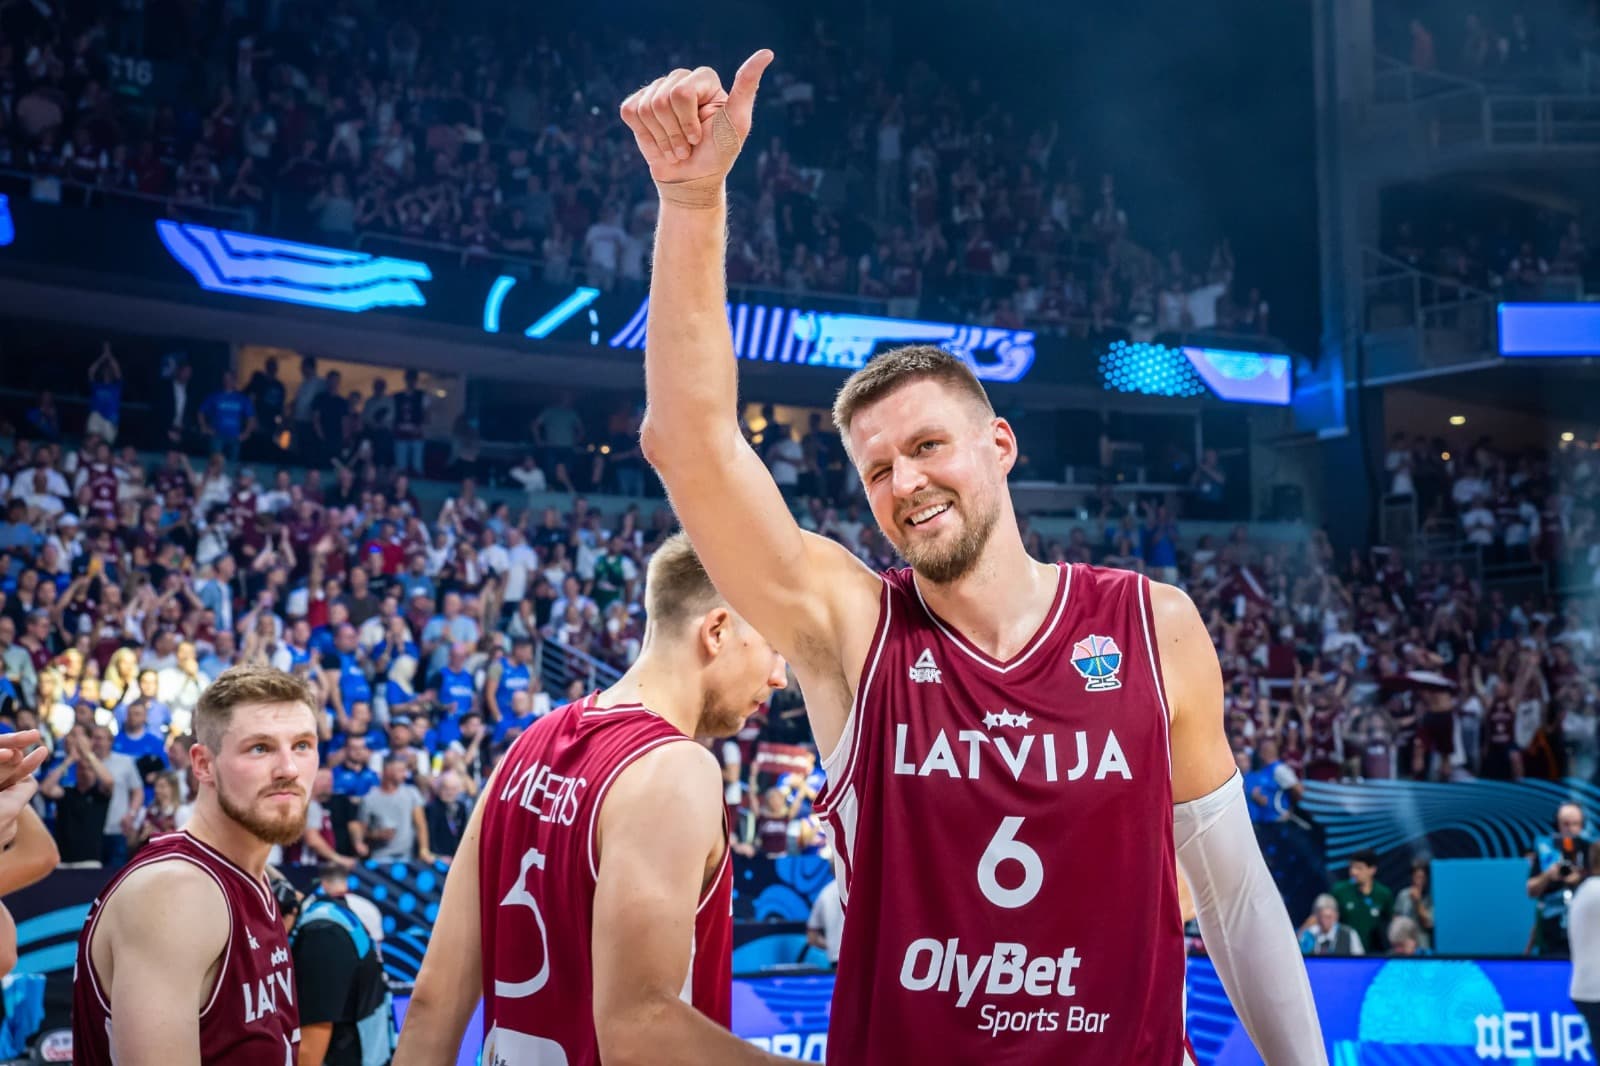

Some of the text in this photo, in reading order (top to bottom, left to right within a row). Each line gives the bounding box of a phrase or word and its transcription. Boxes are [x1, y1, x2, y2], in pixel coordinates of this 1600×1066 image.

[893, 723, 1133, 782] LATVIJA
[977, 816, 1044, 909] 6
[495, 847, 550, 998] 5
[899, 936, 1082, 1008] OlyBet
[977, 1004, 1111, 1037] Sports Bar
